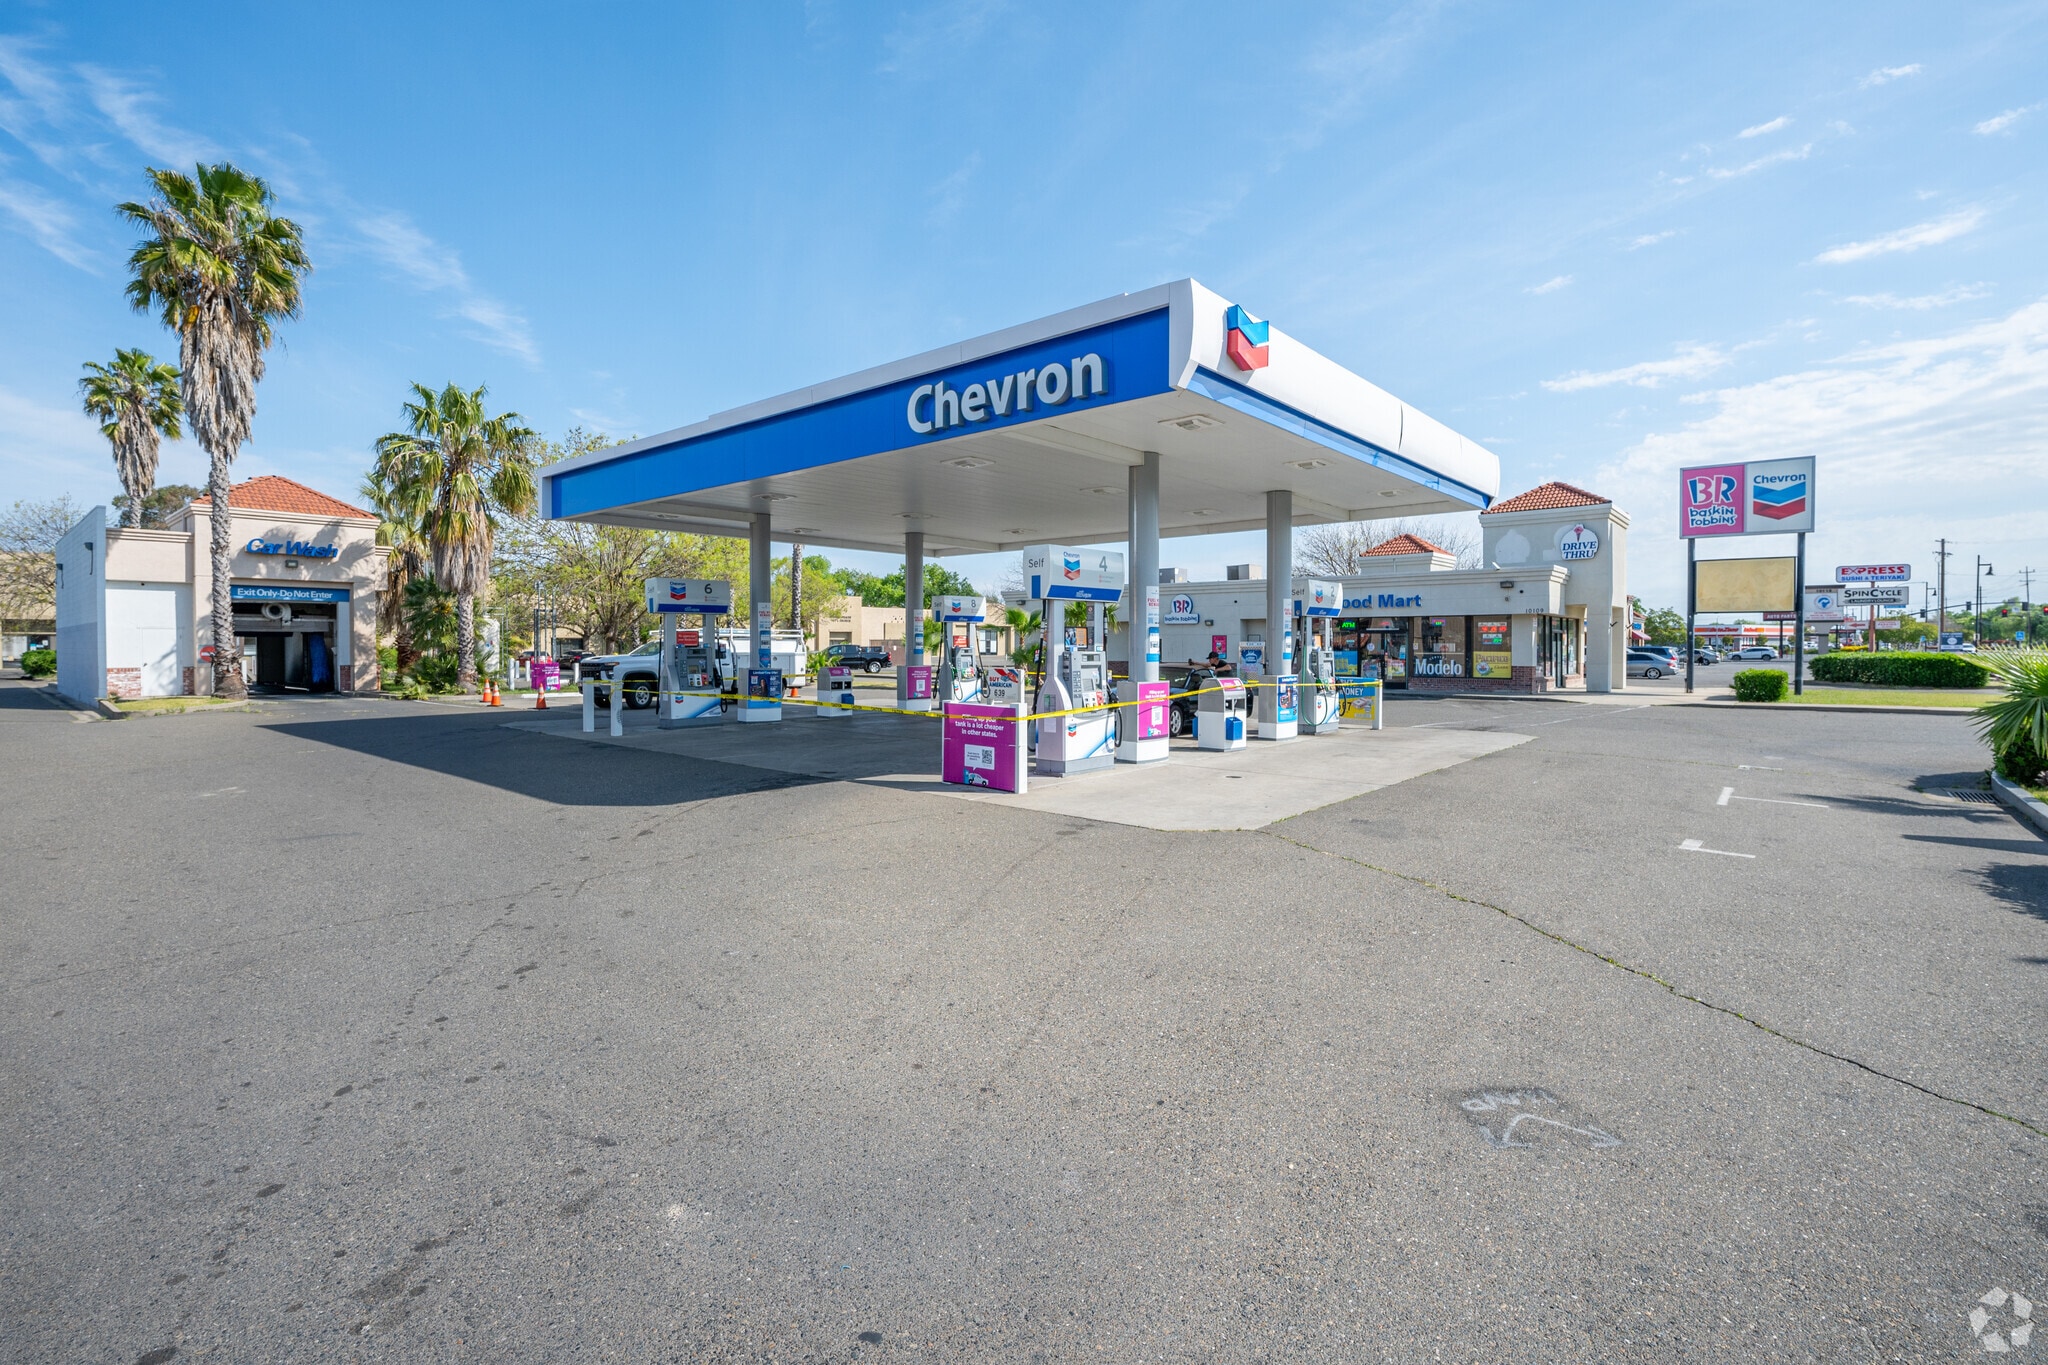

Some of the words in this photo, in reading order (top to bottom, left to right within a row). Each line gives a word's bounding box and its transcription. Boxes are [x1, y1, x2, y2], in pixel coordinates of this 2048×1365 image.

[907, 353, 1108, 434] Chevron
[1753, 473, 1806, 485] Chevron
[1687, 475, 1737, 505] BR
[1689, 504, 1735, 517] baskin
[1690, 515, 1737, 527] robbins
[246, 537, 283, 554] Car
[286, 540, 339, 558] Wash
[1562, 541, 1597, 551] DRIVE
[1563, 550, 1594, 559] THRU
[1028, 557, 1044, 568] Self
[1098, 556, 1108, 572] 4
[1841, 566, 1905, 576] EXPRESS
[237, 588, 256, 596] Exit
[293, 590, 310, 598] Not
[310, 591, 333, 599] Enter
[704, 583, 713, 594] 6
[970, 599, 977, 608] 8
[1173, 600, 1190, 613] BR
[1342, 594, 1373, 609] ood
[1378, 593, 1422, 609] Mart
[1415, 658, 1463, 675] Modelo
